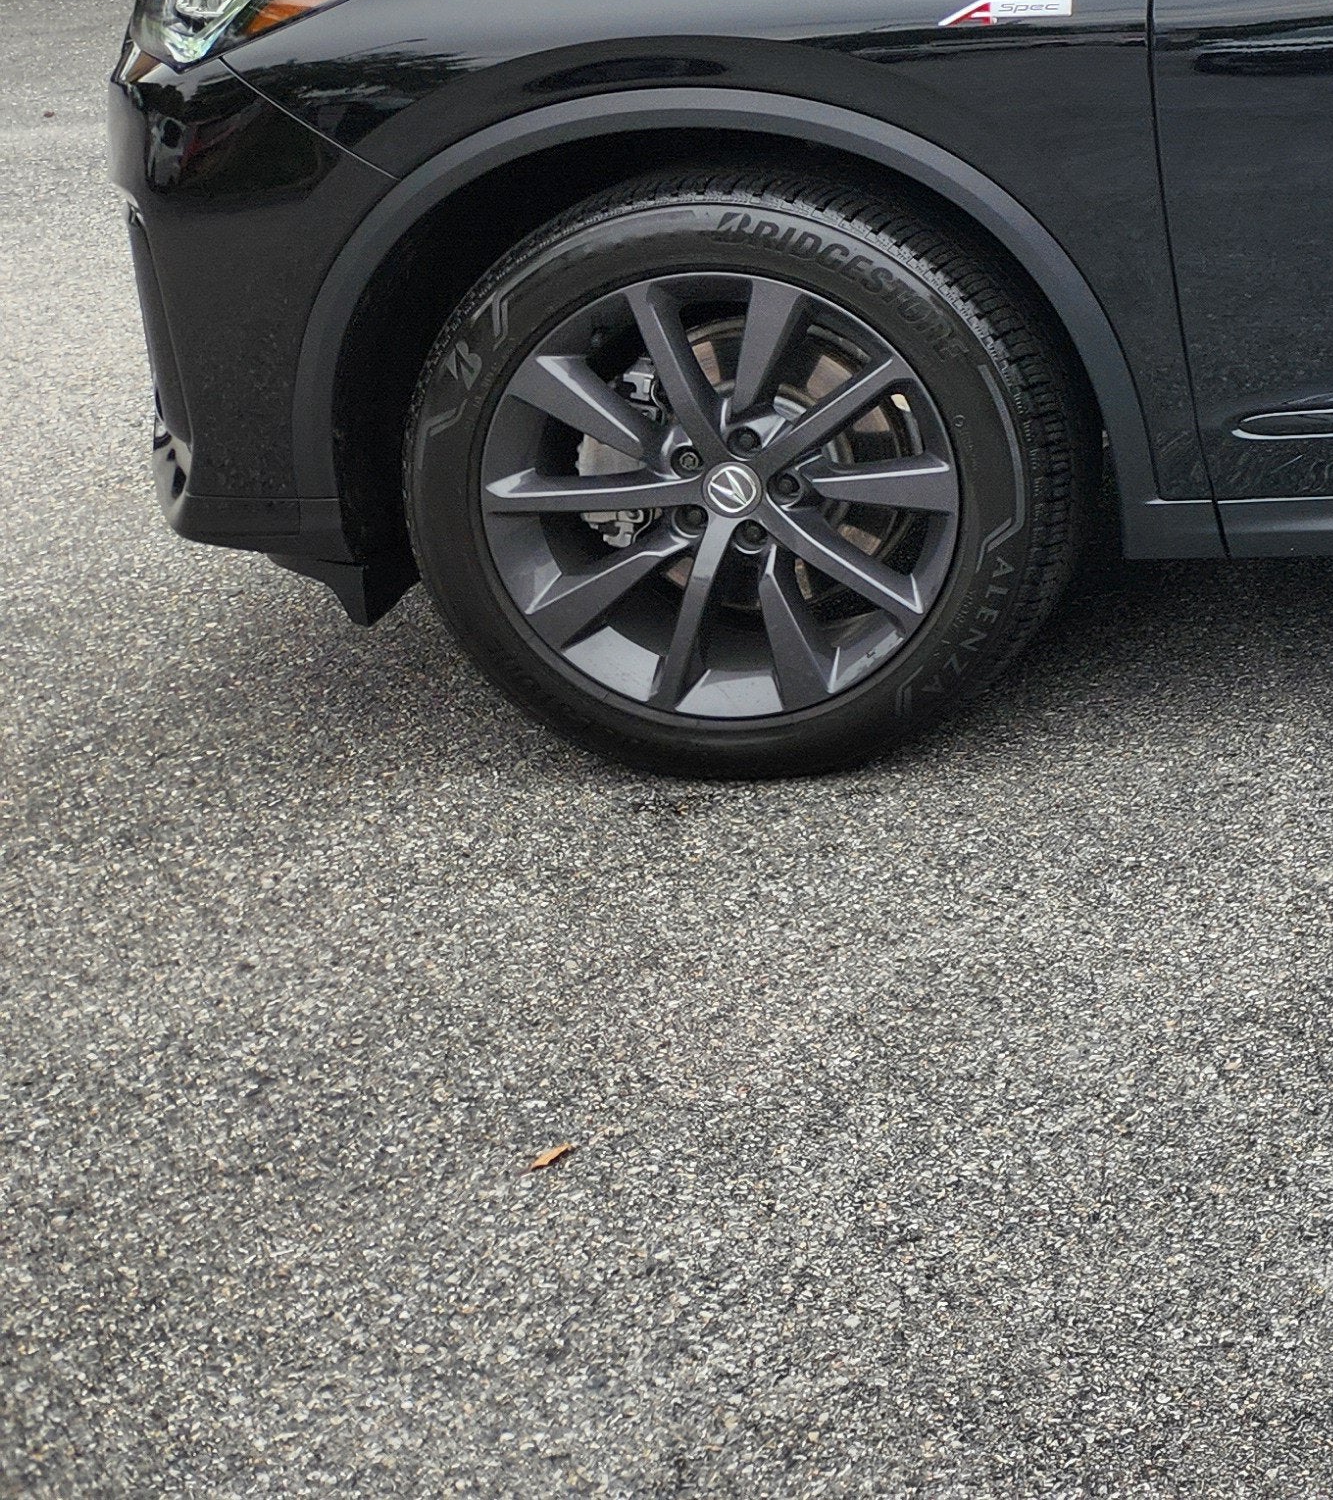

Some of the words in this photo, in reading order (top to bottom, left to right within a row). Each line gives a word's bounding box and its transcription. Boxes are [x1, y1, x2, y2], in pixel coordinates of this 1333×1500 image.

[998, 3, 1060, 14] Spec
[714, 210, 970, 364] BRIDGESTONE
[920, 554, 1015, 693] ALENZA
